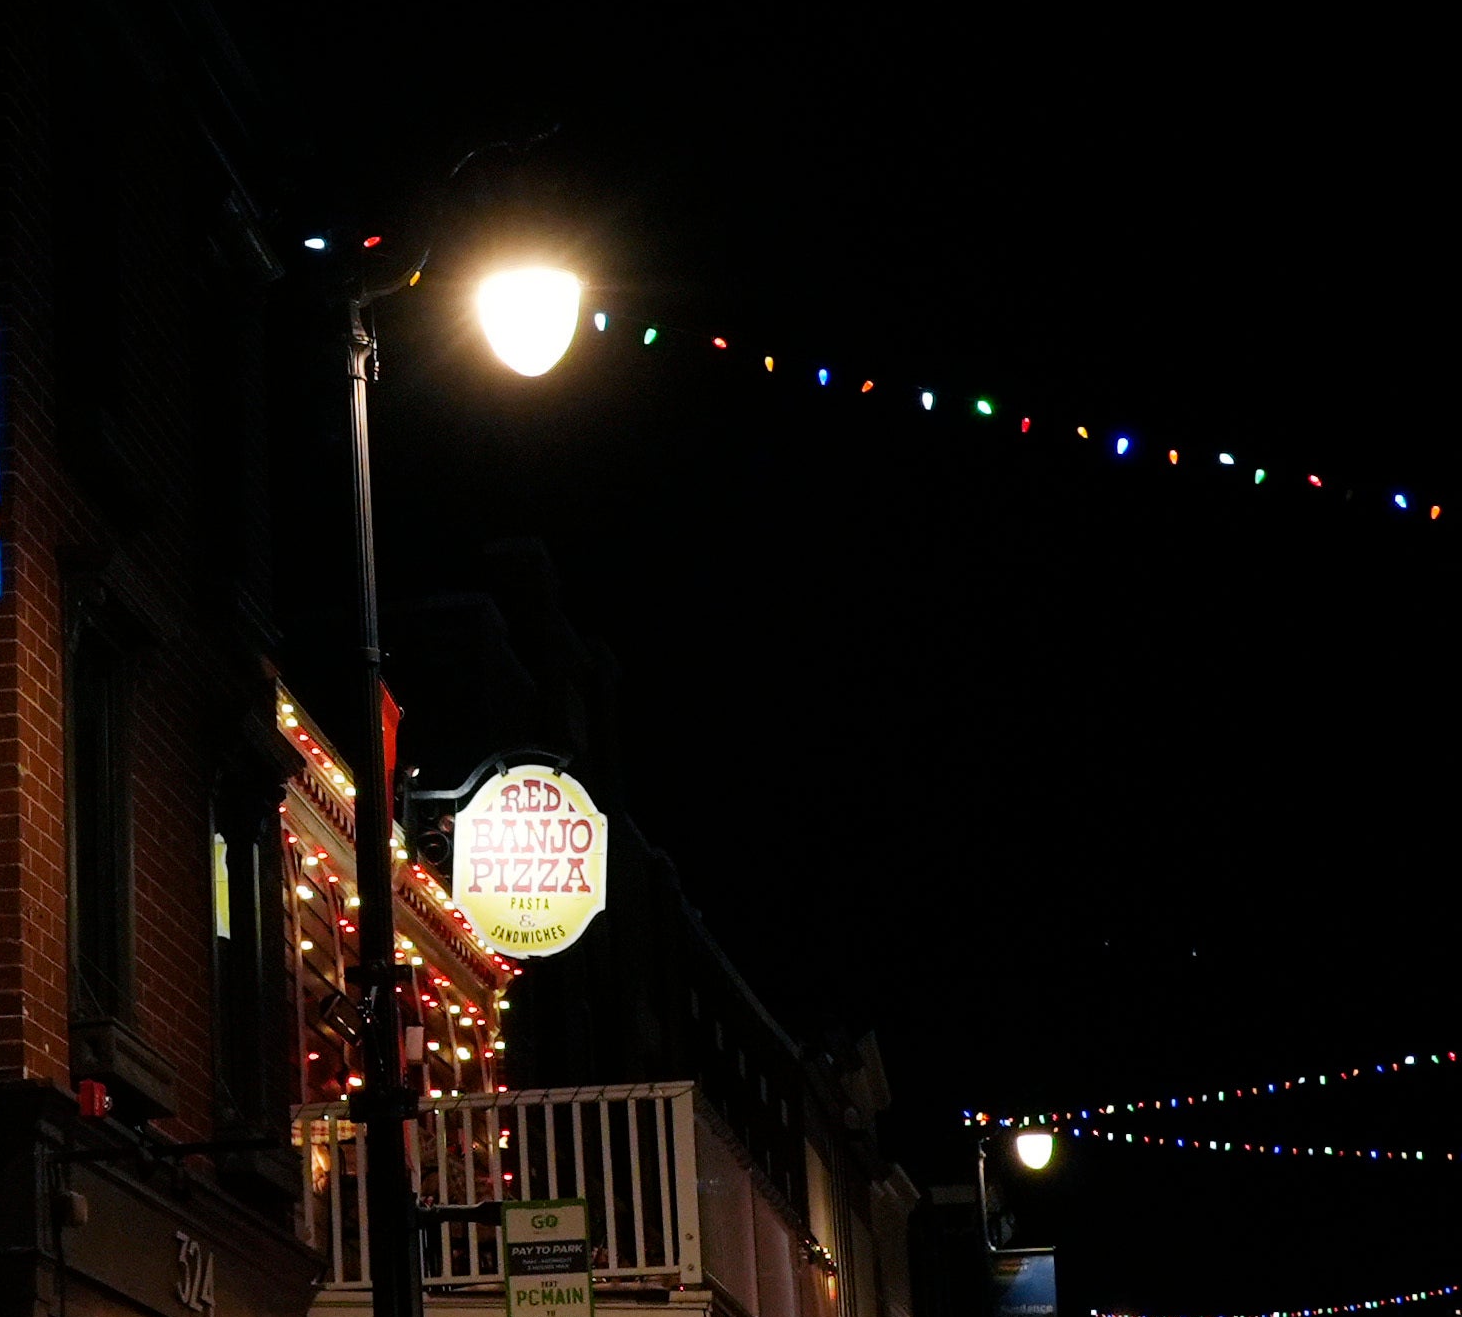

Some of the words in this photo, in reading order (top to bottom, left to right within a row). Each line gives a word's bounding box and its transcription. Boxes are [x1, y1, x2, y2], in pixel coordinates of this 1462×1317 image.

[501, 780, 561, 813] RED
[470, 818, 593, 854] BANJO
[468, 858, 591, 893] PIZZA
[510, 897, 550, 911] PASTA
[490, 924, 567, 944] SANDWICHES
[511, 1246, 534, 1257] PAY
[535, 1245, 552, 1255] TO
[552, 1243, 583, 1254] PARK
